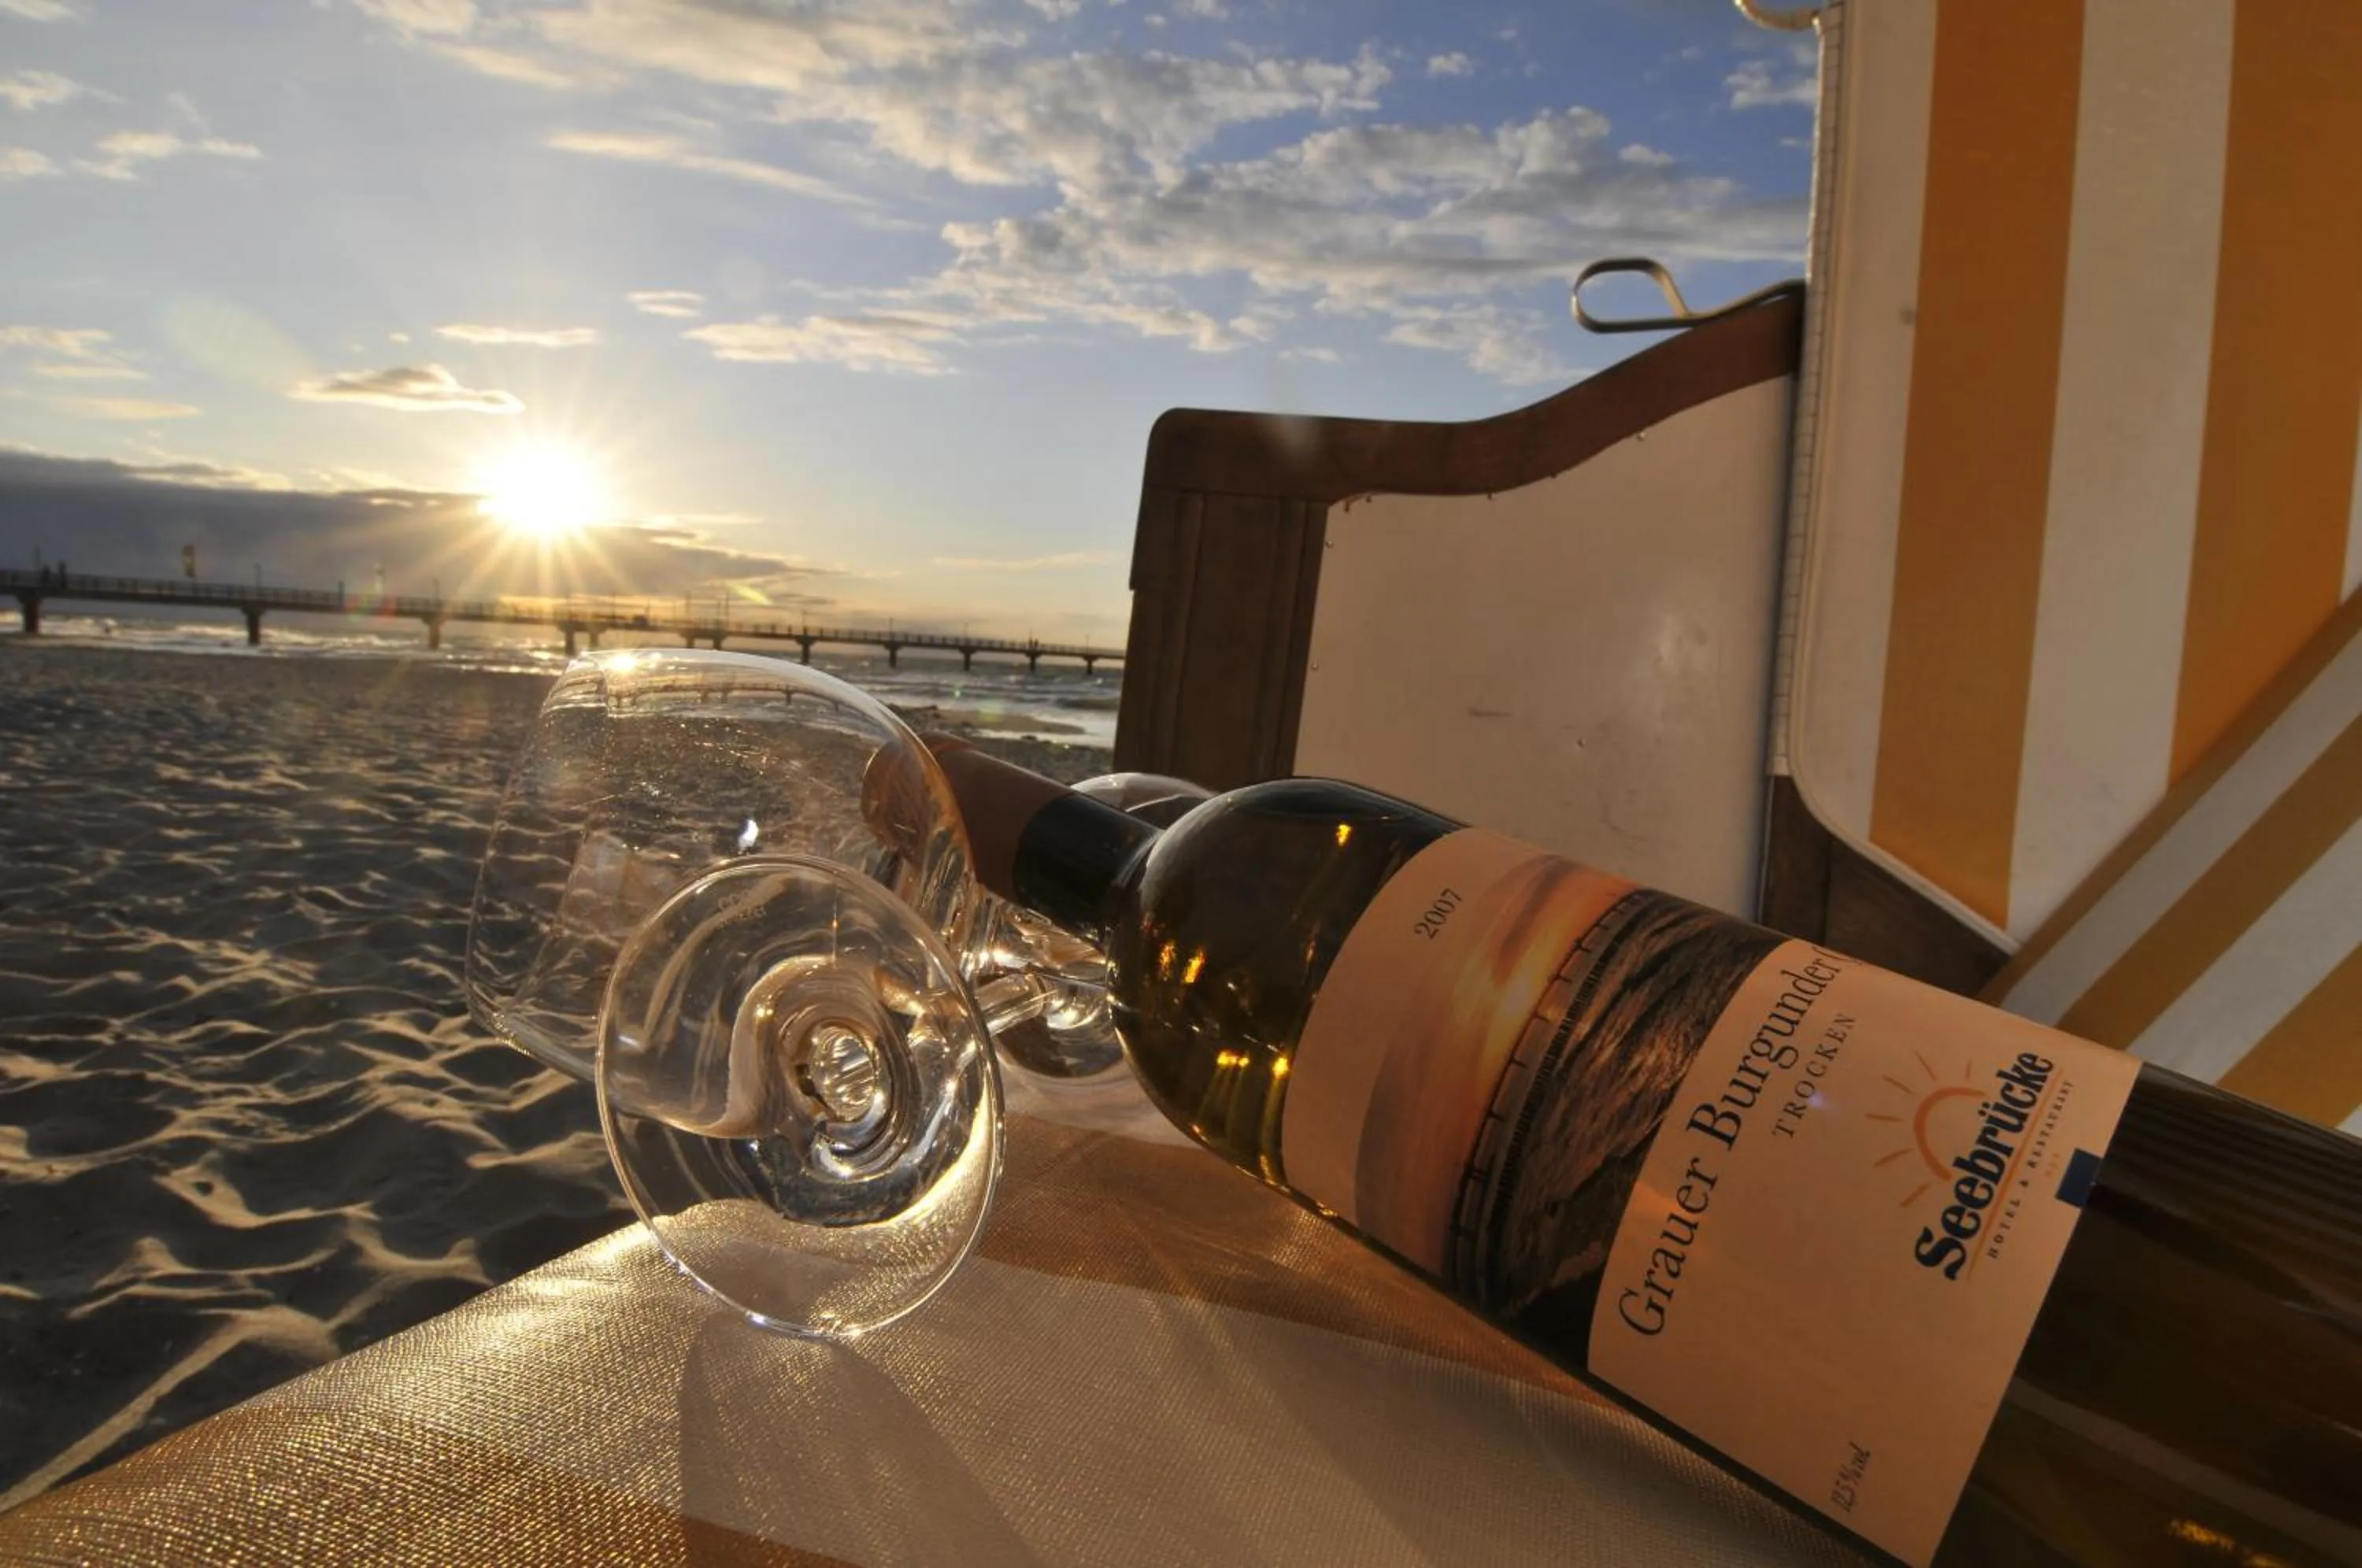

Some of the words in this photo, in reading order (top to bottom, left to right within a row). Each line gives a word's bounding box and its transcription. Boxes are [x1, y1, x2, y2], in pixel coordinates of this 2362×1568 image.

[1413, 887, 1463, 940] 2007
[1772, 1012, 1857, 1139] TROCKEN
[1618, 1156, 1719, 1337] Grauer
[1686, 957, 1842, 1152] Burgunder
[1913, 1052, 2054, 1281] Seebrücke
[1986, 1198, 2021, 1259] HOTEL
